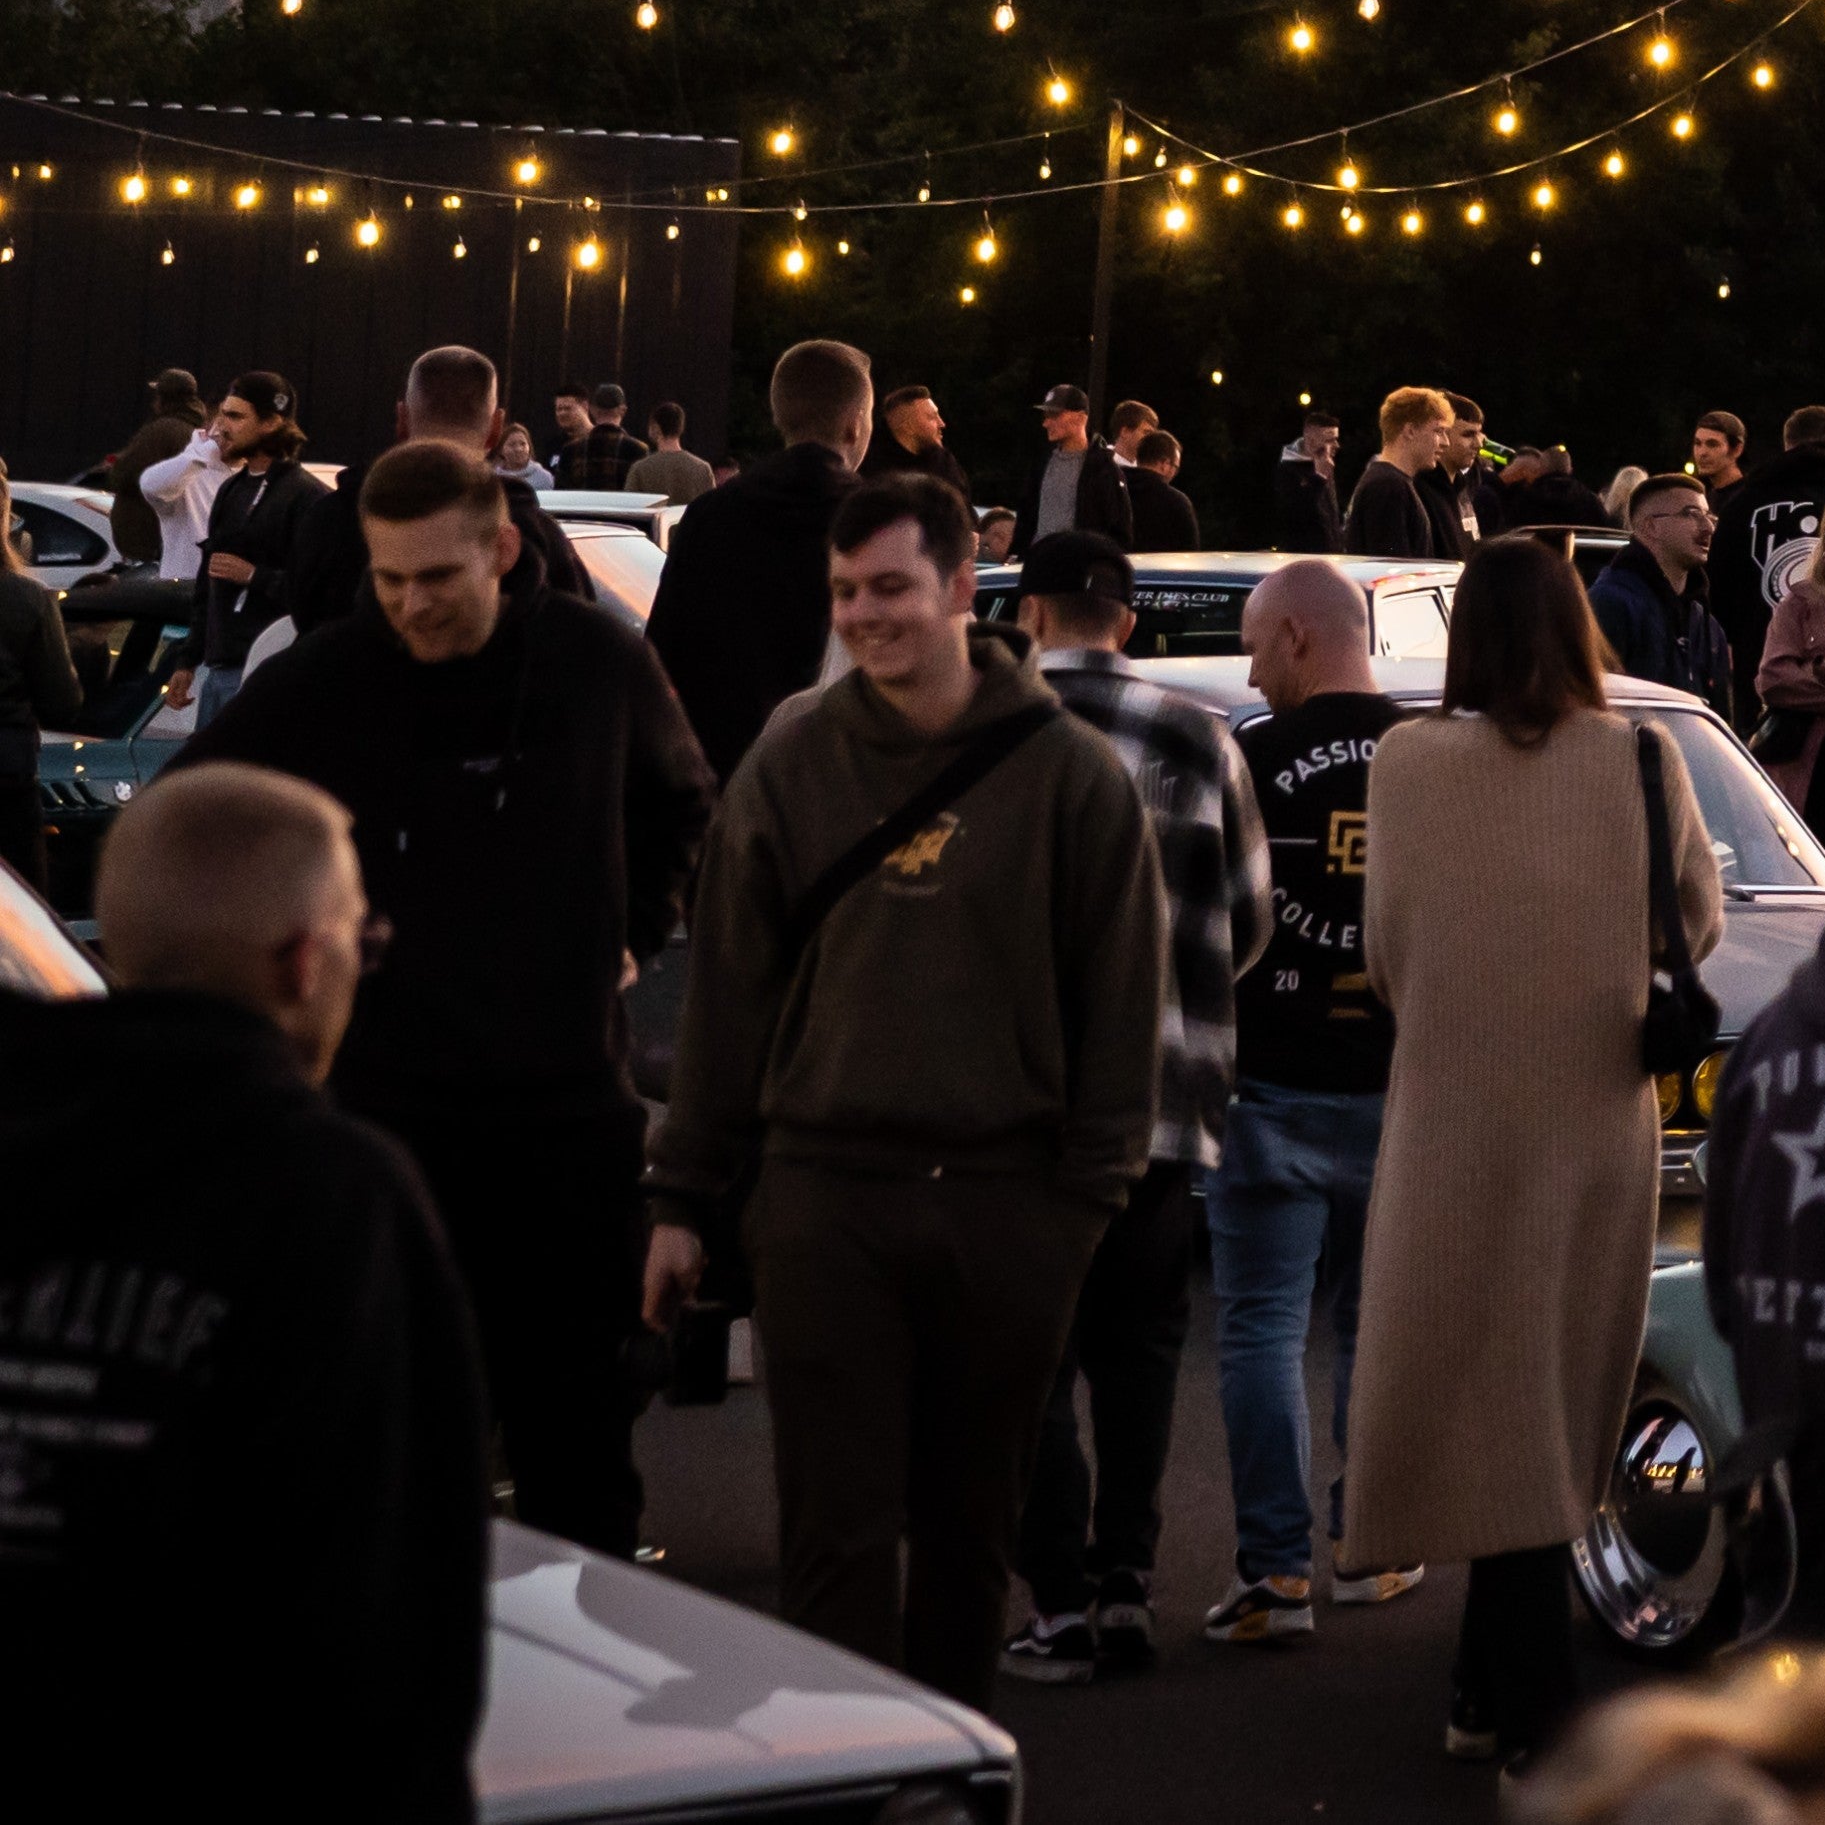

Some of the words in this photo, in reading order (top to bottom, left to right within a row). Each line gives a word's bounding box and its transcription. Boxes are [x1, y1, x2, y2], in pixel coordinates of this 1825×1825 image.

[1191, 592, 1231, 603] CLUB
[1275, 738, 1379, 795] PASSIO
[1271, 886, 1358, 950] COLLE
[1275, 969, 1300, 992] 20
